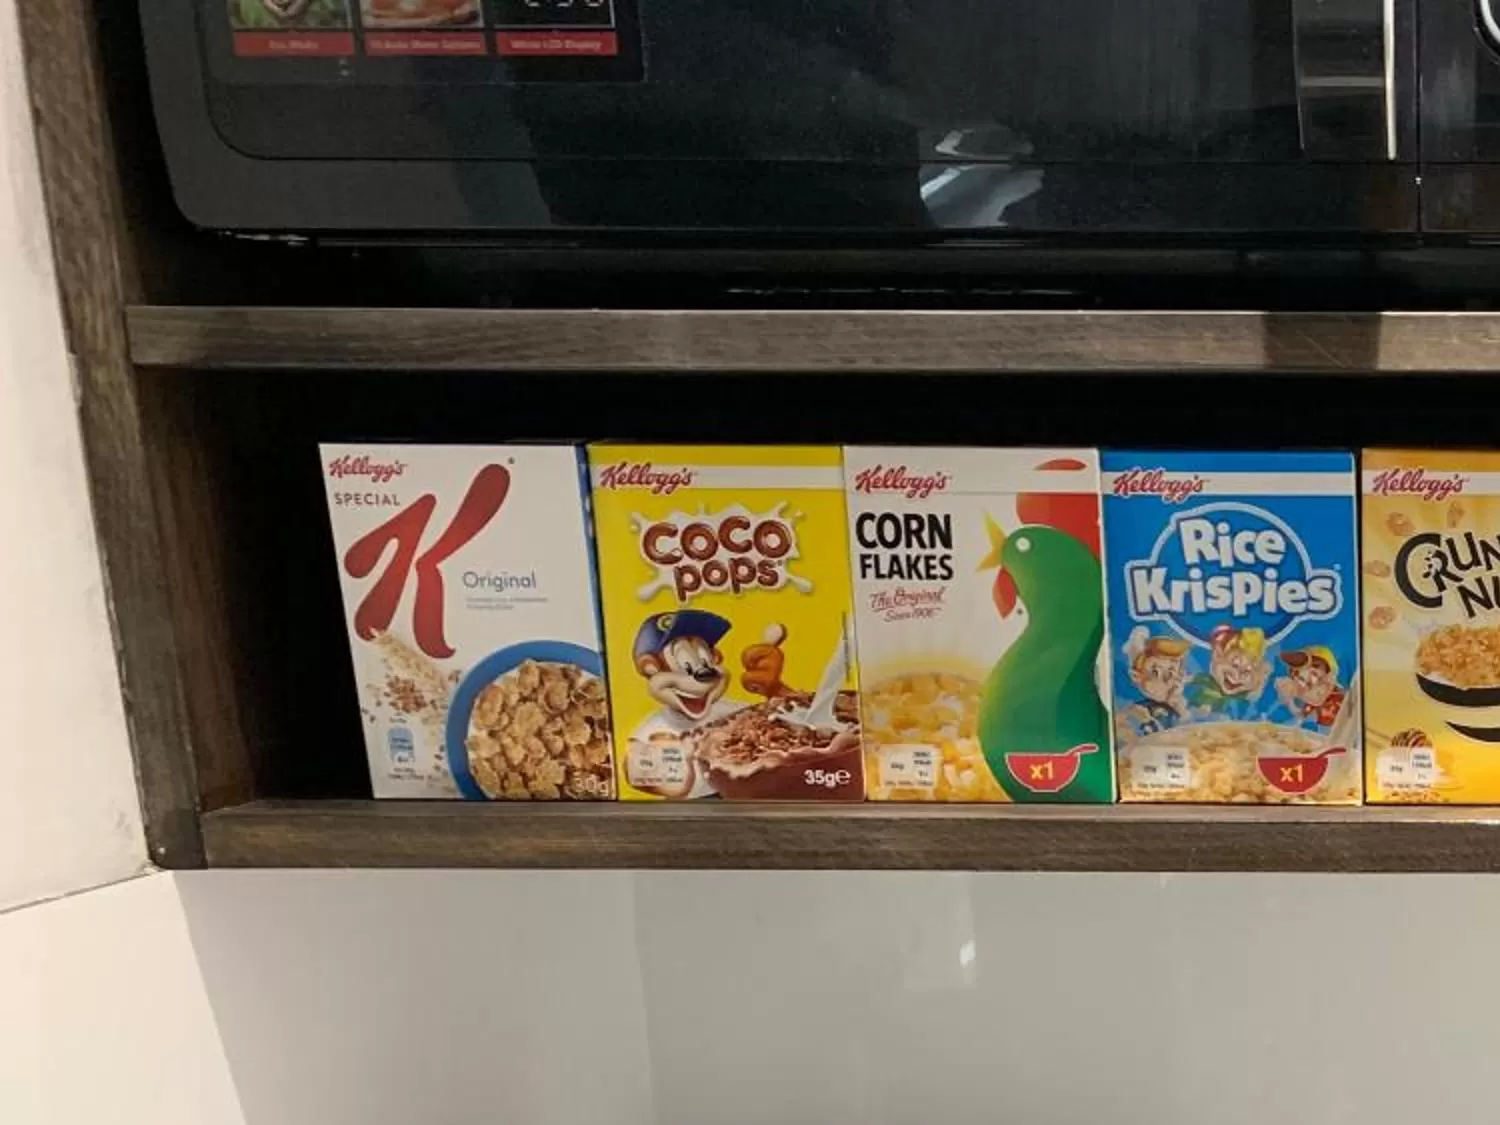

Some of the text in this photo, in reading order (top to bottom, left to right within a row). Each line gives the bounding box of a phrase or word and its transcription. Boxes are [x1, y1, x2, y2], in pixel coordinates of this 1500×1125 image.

[329, 455, 404, 482] Kellogg's
[600, 462, 693, 494] Kellogg's
[855, 465, 947, 498] Kellogg's
[1373, 468, 1466, 500] Kellogg's
[334, 492, 401, 507] SPECIAL
[1113, 470, 1203, 502] Kellogg's
[642, 515, 793, 565] COCO
[855, 512, 954, 550] CORN
[1179, 517, 1287, 568] Rice
[462, 571, 537, 593] Original
[673, 557, 780, 602] pops
[859, 553, 954, 581] FLAKES
[1130, 565, 1337, 617] Krispies
[1029, 760, 1056, 780] x1
[1279, 763, 1305, 784] x1
